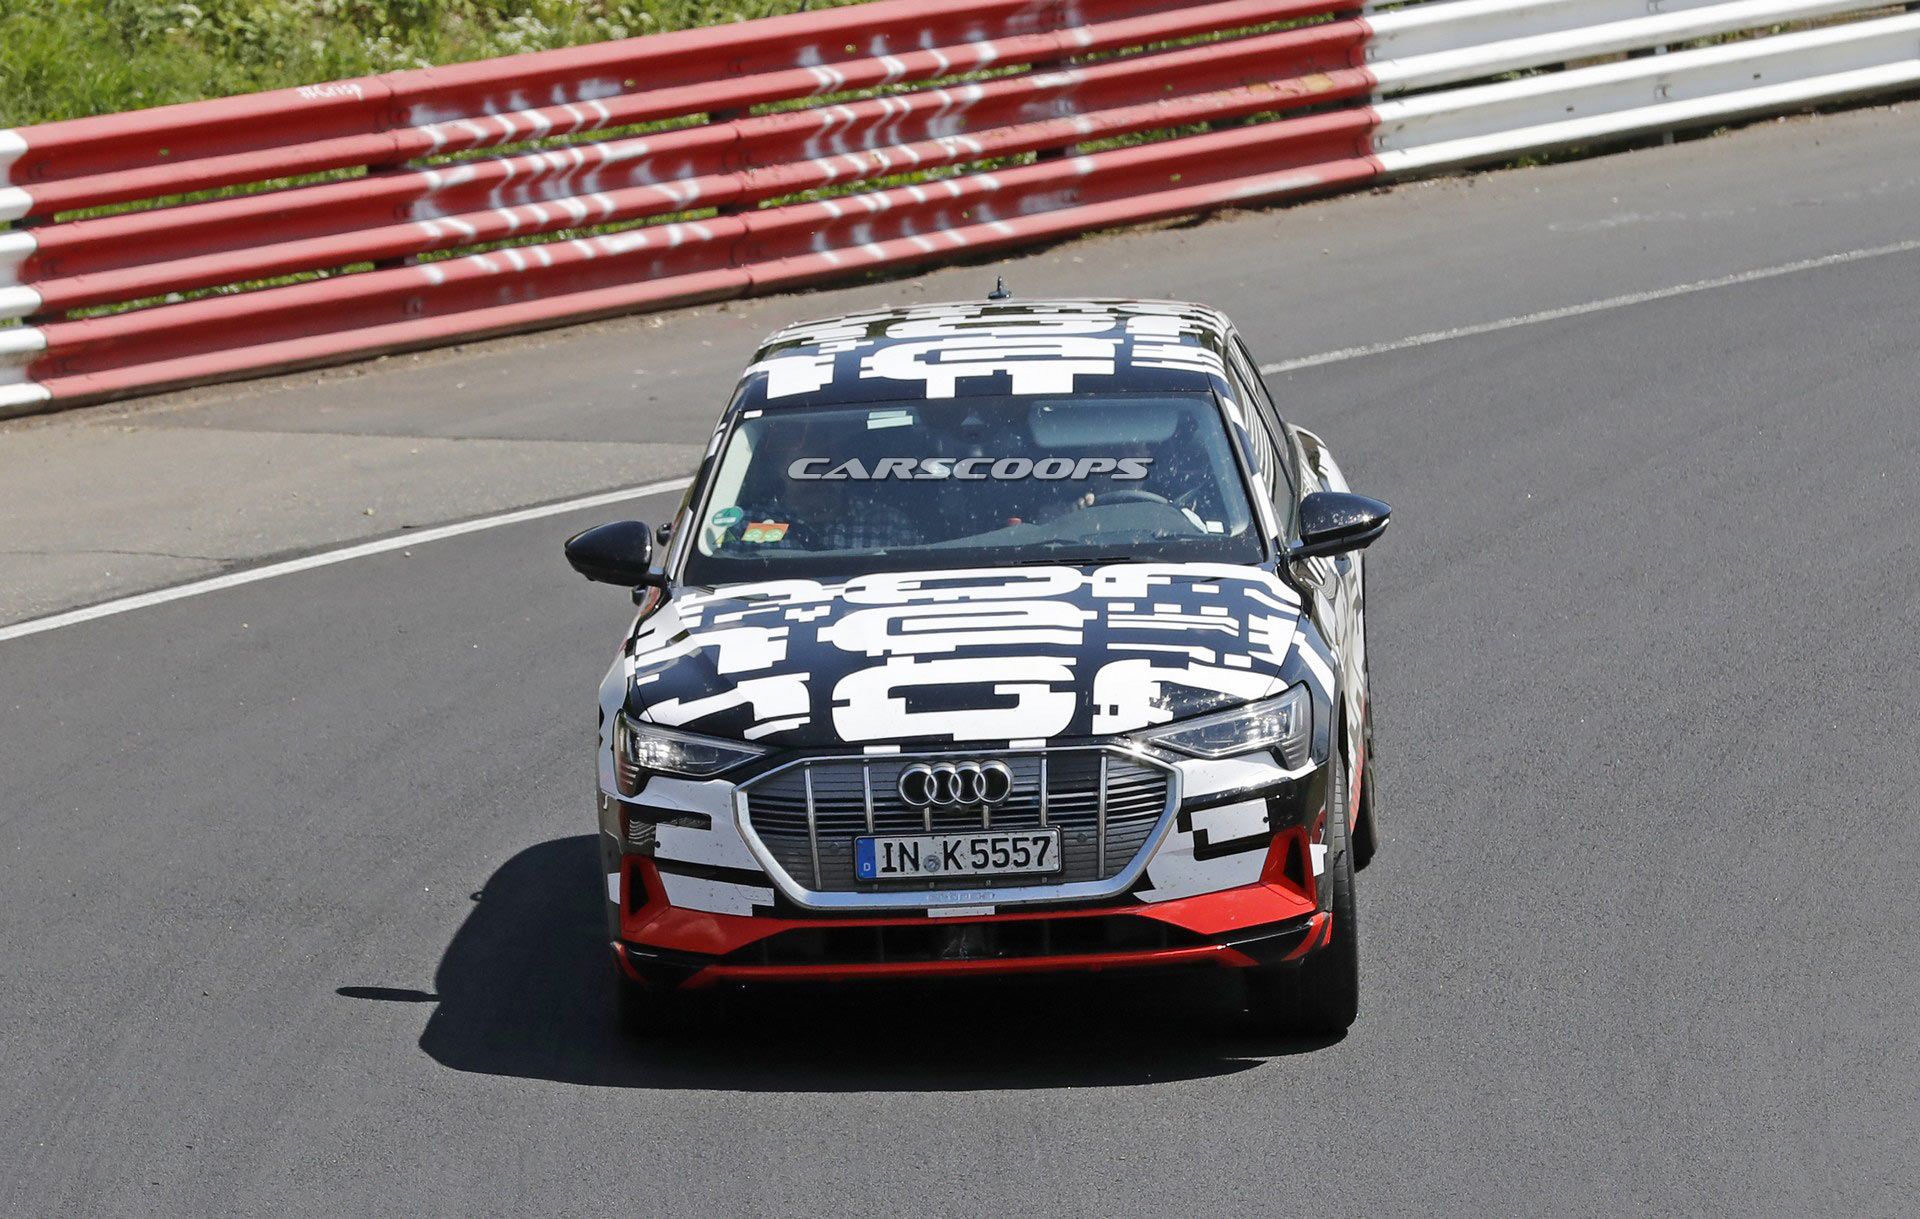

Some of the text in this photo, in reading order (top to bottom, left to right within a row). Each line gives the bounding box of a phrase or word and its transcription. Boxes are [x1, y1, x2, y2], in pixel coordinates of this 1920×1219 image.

[881, 836, 1051, 872] IN K 5557
[862, 862, 872, 872] D
